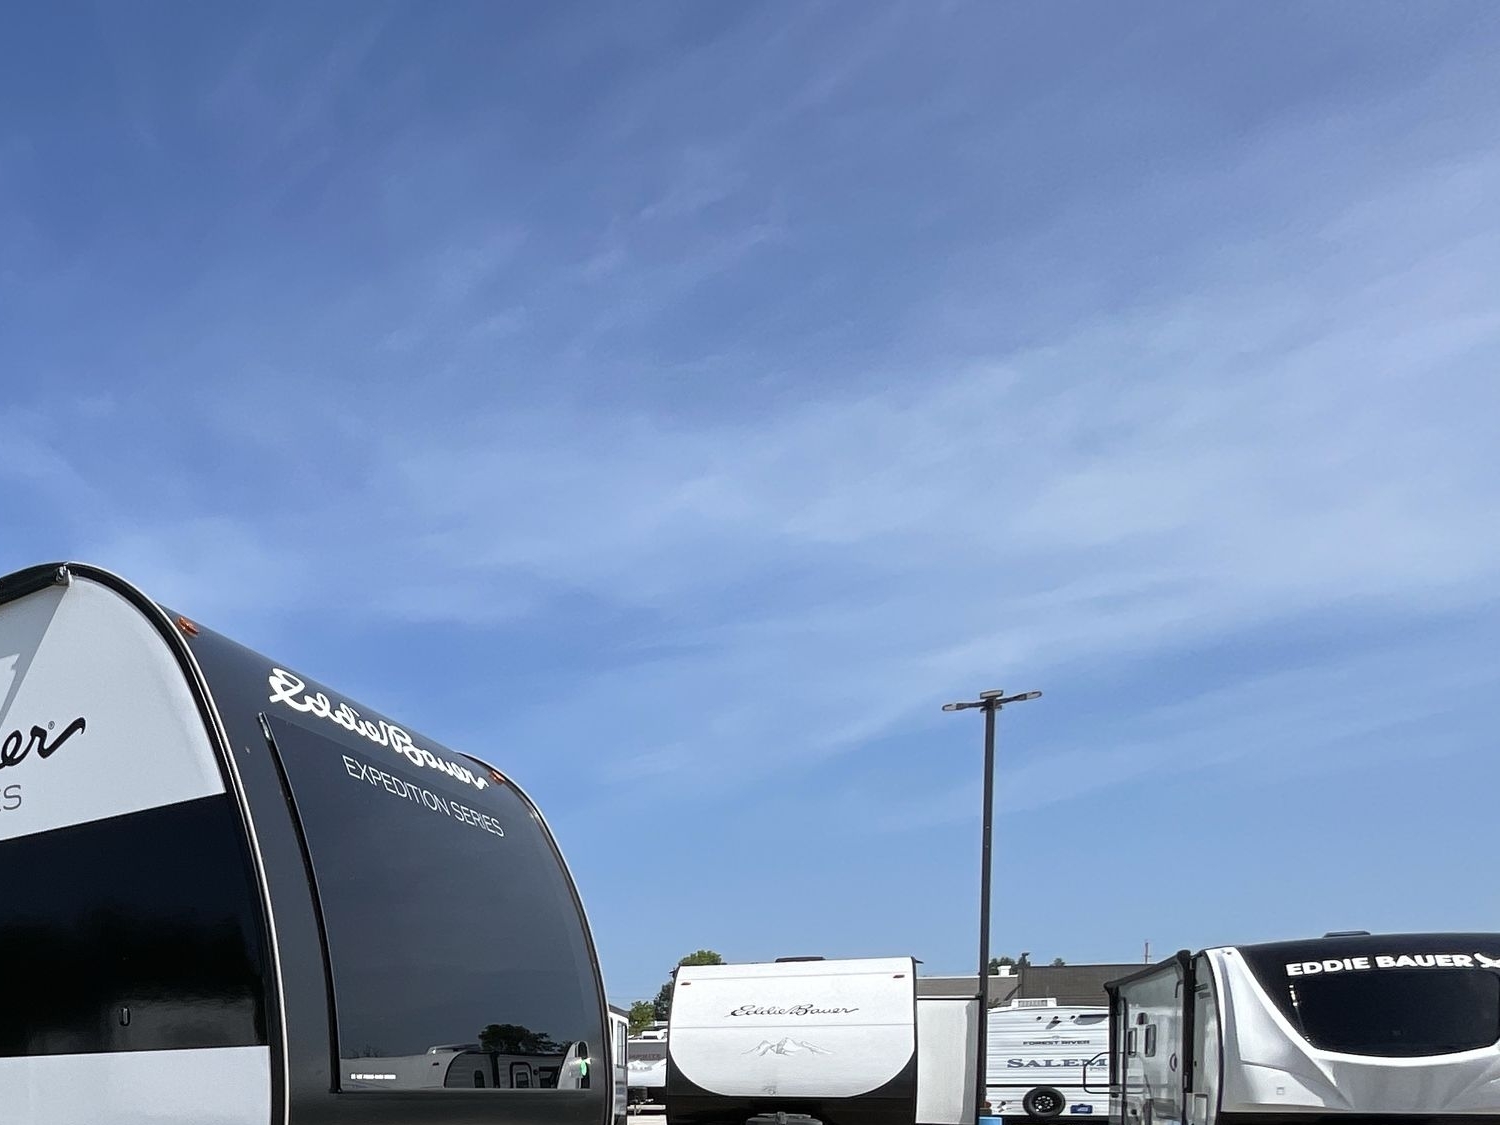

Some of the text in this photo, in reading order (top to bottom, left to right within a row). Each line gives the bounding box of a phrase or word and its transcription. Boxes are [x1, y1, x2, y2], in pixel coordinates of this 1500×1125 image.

[268, 668, 489, 790] Eddie Bauer
[342, 755, 505, 837] EXPEDITION SERIES
[1286, 954, 1474, 976] EDDIE BAUER
[723, 1004, 860, 1018] Eddie Bauer
